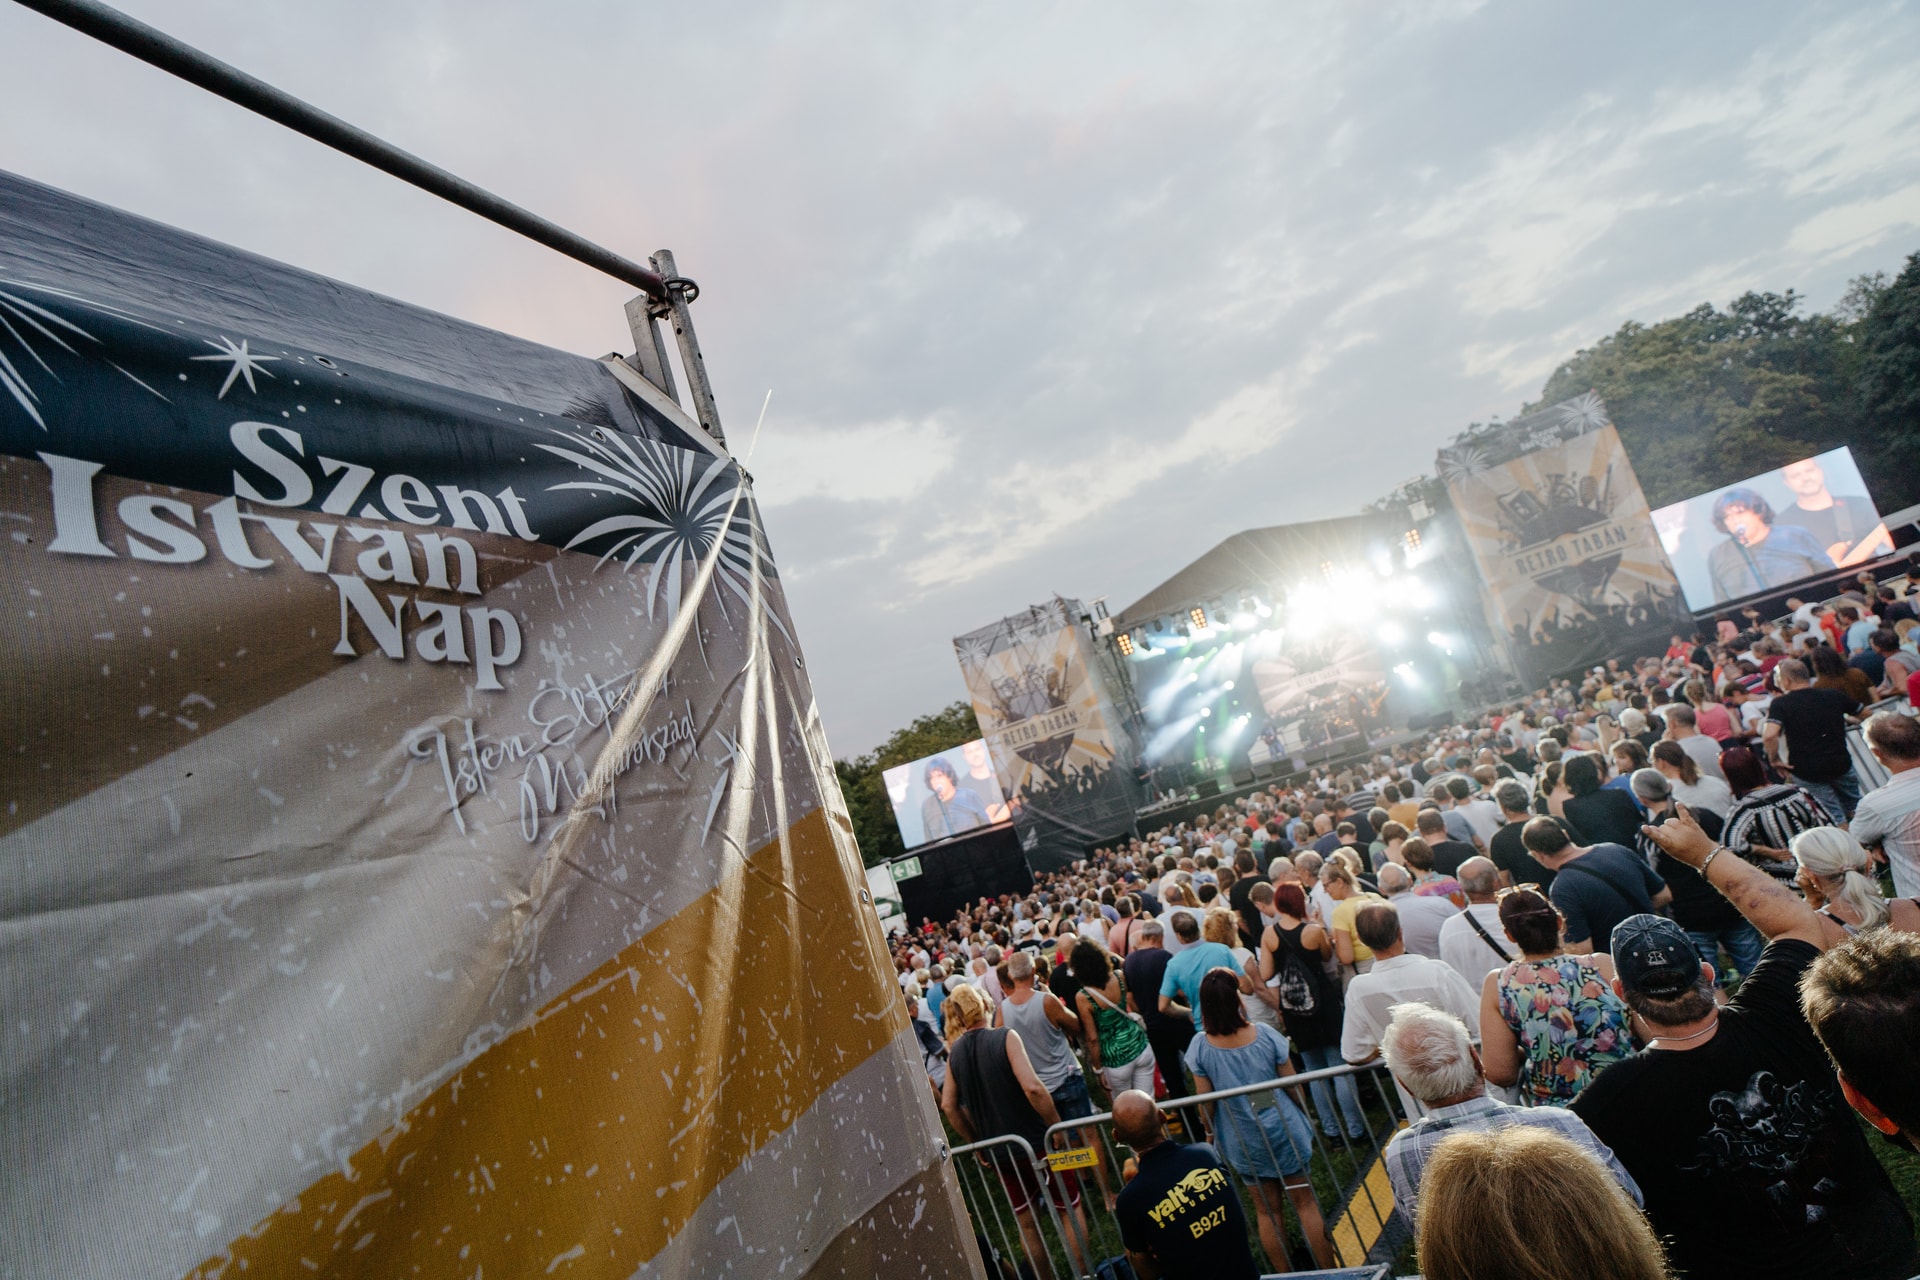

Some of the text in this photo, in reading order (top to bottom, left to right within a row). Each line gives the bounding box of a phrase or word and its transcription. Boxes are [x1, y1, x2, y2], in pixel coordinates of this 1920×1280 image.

[229, 421, 540, 541] Szent
[1515, 544, 1568, 575] RETRO
[328, 573, 522, 690] Nap
[1003, 723, 1038, 746] RETRO
[1049, 1151, 1092, 1166] profirent
[1158, 1179, 1229, 1229] SECURITY
[1189, 1205, 1227, 1239] B927
